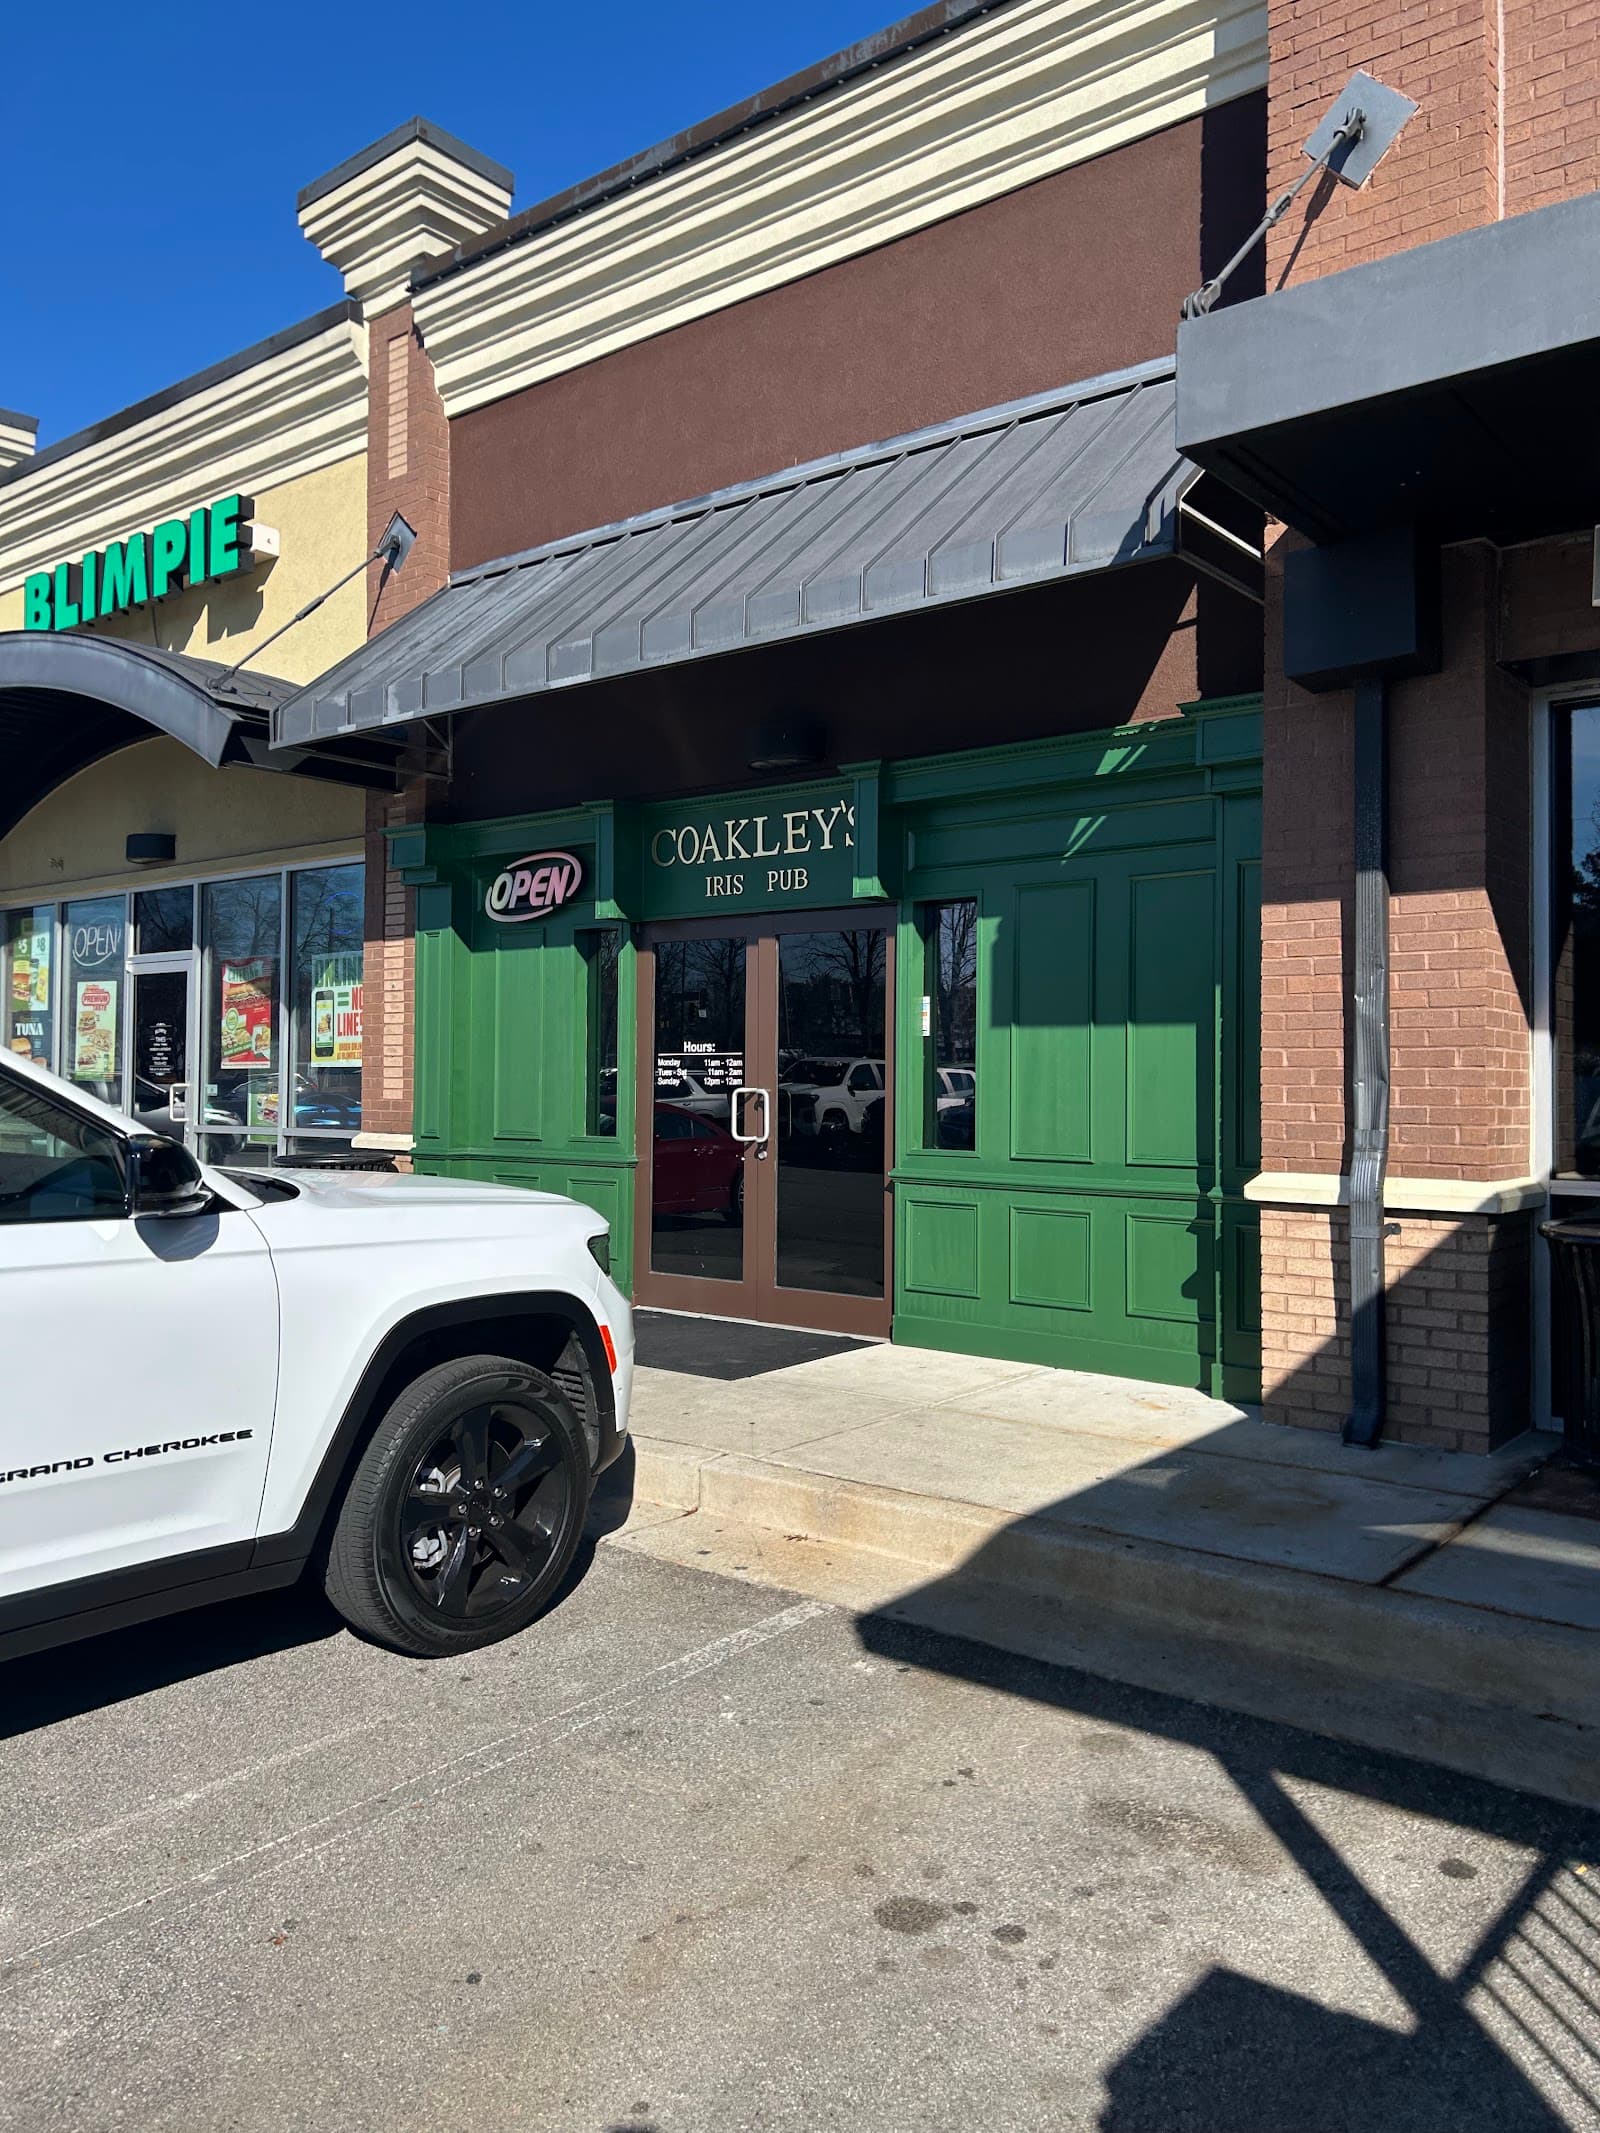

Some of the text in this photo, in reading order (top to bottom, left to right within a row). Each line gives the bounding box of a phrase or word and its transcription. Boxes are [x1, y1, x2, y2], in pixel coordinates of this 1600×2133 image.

[24, 494, 241, 631] BLIMPIE
[491, 865, 571, 910] OPEN
[705, 868, 808, 897] IRIS PUB
[18, 938, 28, 953] $5
[37, 937, 46, 952] $8
[74, 925, 118, 957] OPEN
[15, 1022, 44, 1036] TUNA
[683, 1041, 716, 1053] Hours:
[657, 1058, 681, 1067] Monday
[725, 1058, 743, 1066] 12am
[658, 1068, 673, 1076] Tues
[677, 1068, 687, 1076] Sat
[657, 1078, 680, 1086] Sunday
[704, 1078, 720, 1086] 12pm
[0, 1428, 254, 1483] RAND CHEROKEE
